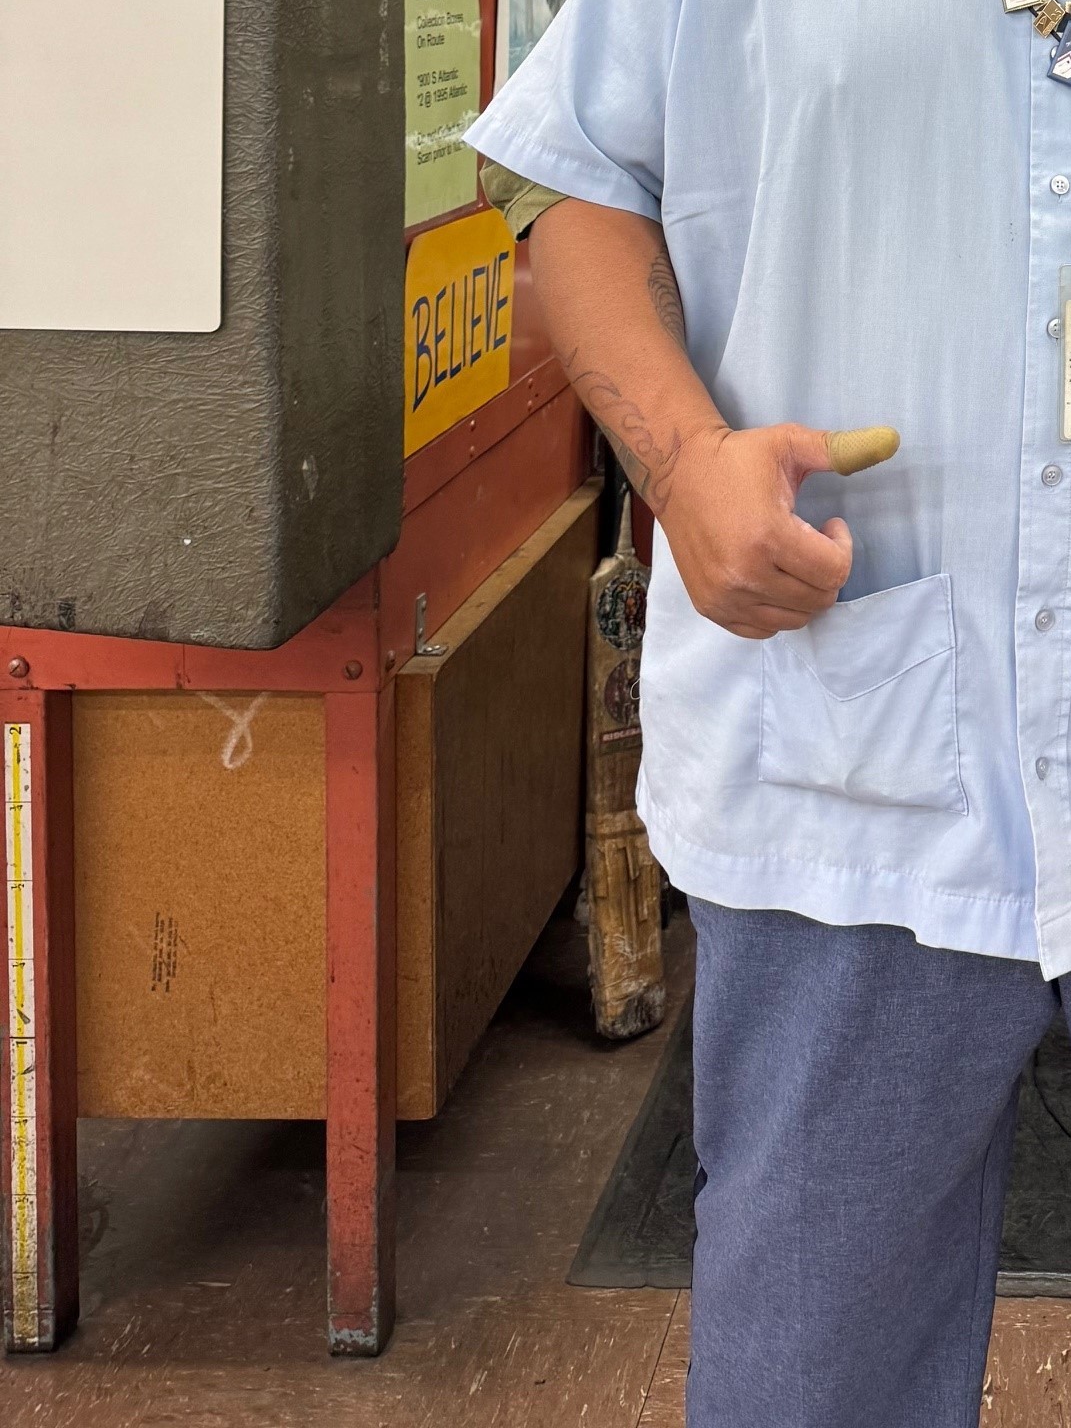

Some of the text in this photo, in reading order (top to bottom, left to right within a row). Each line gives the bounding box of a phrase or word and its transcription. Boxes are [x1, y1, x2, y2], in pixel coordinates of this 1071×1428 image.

[417, 12, 463, 29] Collection Boxes
[417, 33, 445, 49] On Route
[432, 71, 437, 85] S
[438, 67, 459, 83] Atlantic
[425, 91, 432, 108] @
[433, 87, 448, 103] 1995
[449, 83, 468, 99] Atlantic
[417, 151, 432, 165] Scan
[433, 147, 445, 163] prior
[412, 251, 509, 413] BELIEVE
[9, 726, 22, 735] 2
